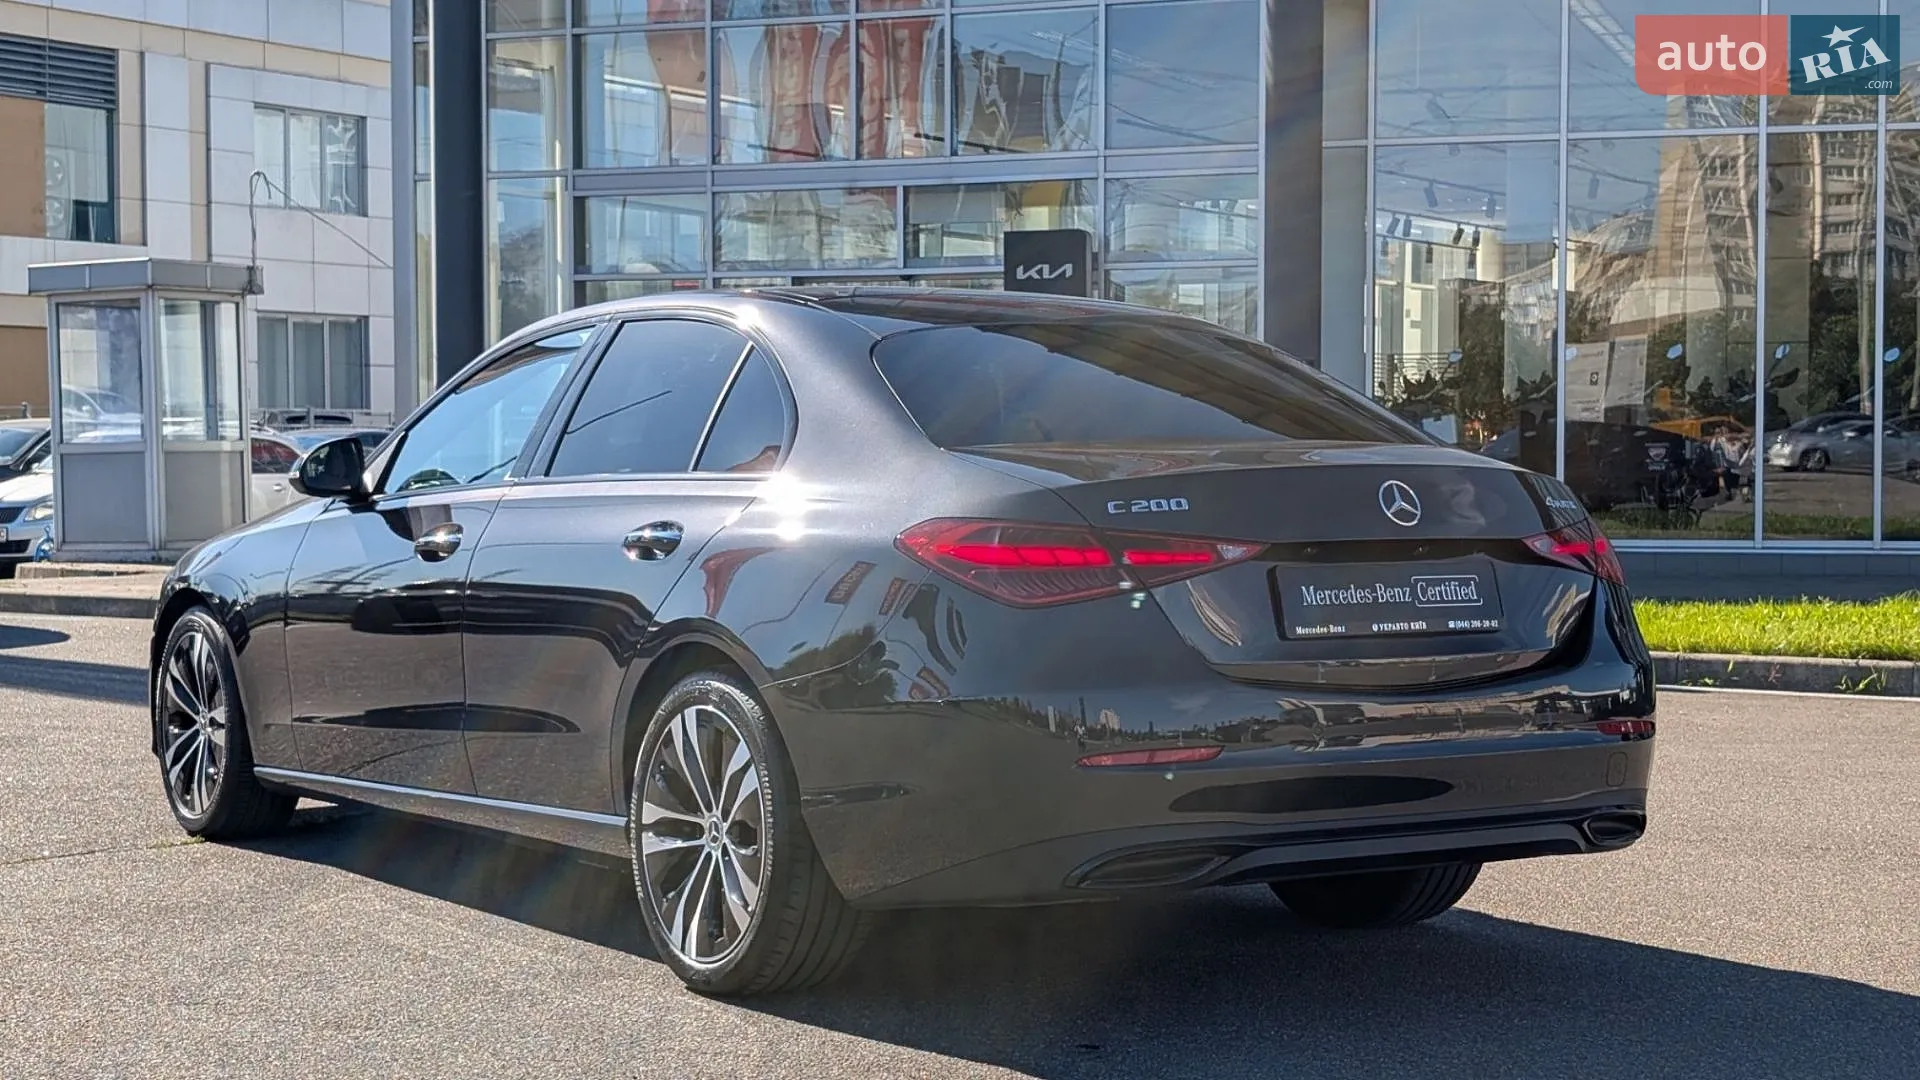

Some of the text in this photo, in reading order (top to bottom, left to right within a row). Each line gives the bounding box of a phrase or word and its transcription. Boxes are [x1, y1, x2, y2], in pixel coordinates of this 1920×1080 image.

[1107, 498, 1189, 514] C 200
[1301, 580, 1478, 606] Mercedes-Benz Certified
